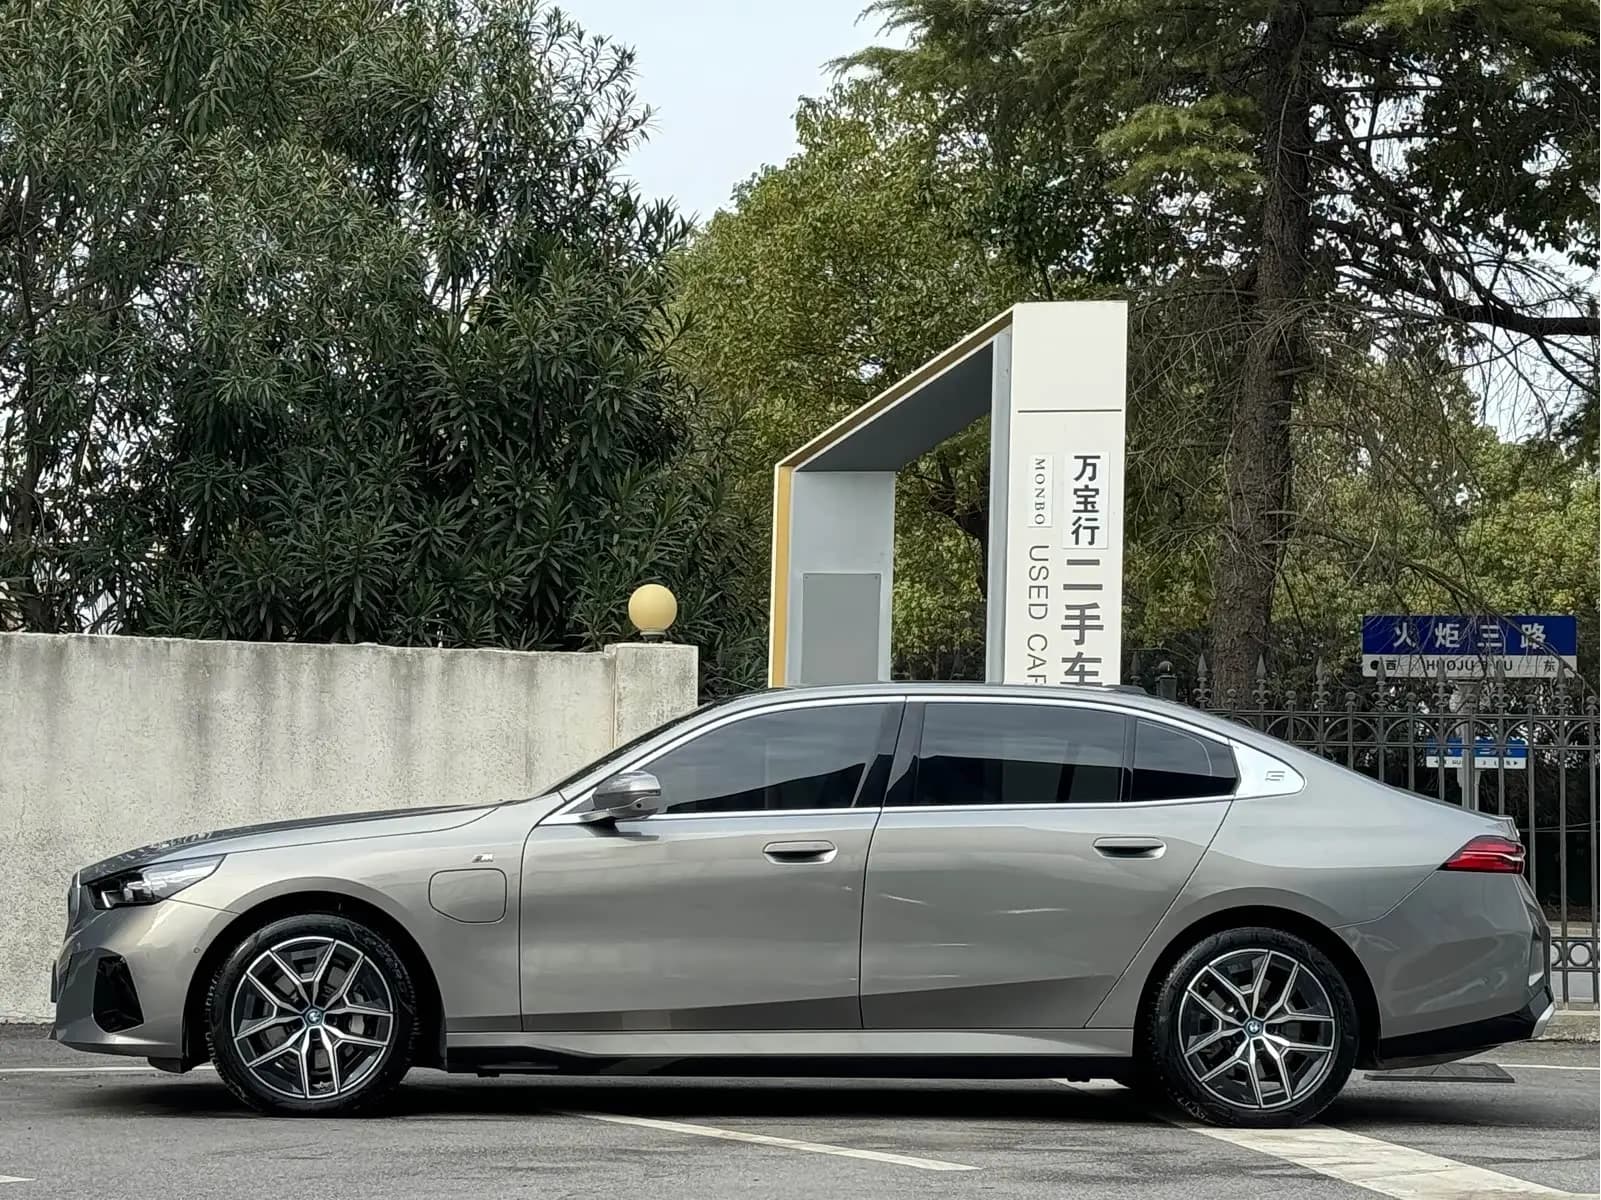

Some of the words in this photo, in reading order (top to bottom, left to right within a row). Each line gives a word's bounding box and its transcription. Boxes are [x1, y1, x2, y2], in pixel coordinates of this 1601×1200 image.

[1034, 458, 1046, 525] MONBO
[1071, 455, 1101, 546] 万宝行
[1028, 545, 1050, 620] USED
[1393, 622, 1546, 650] 火炬三路
